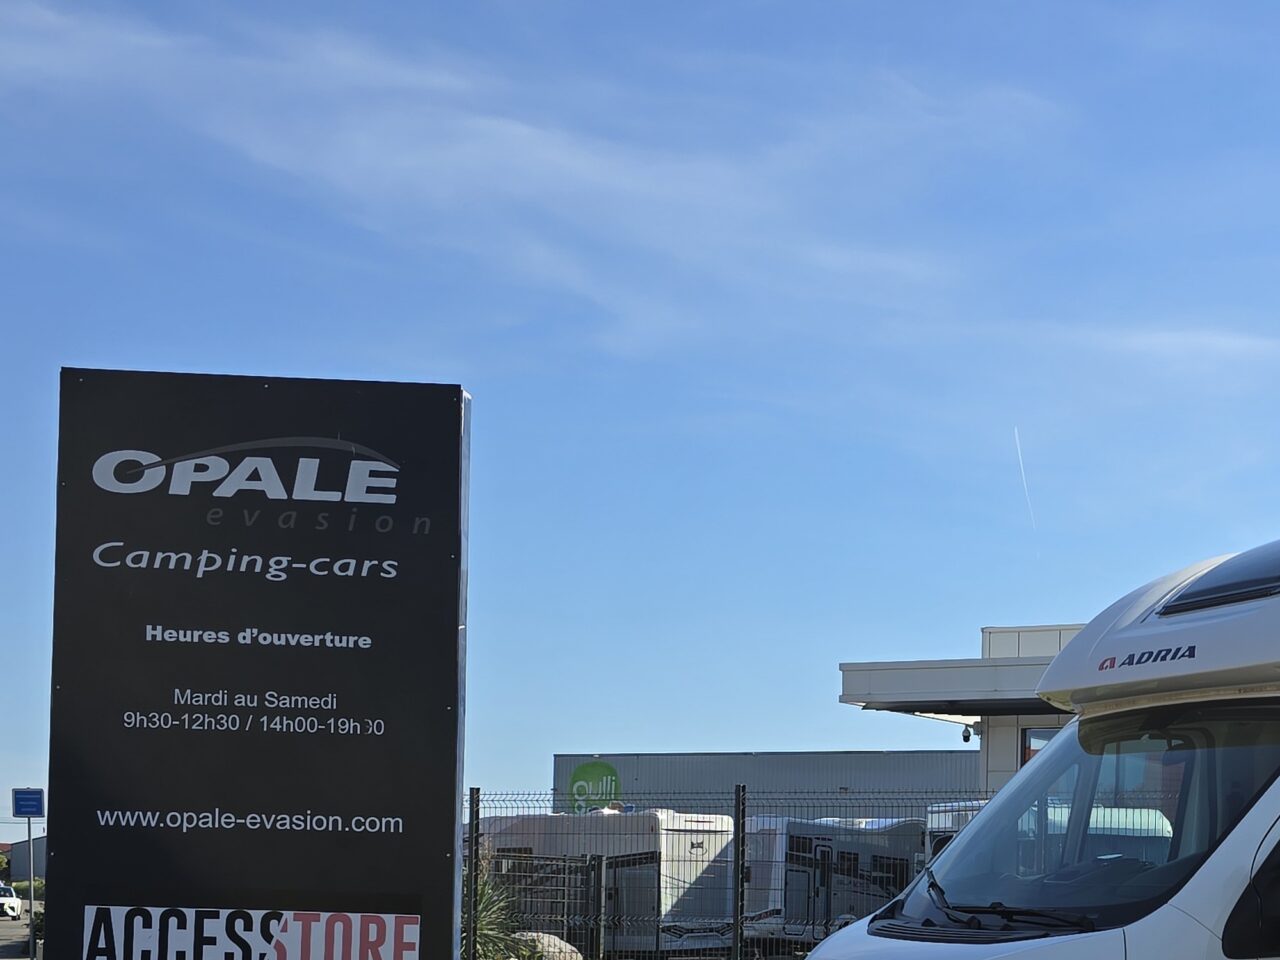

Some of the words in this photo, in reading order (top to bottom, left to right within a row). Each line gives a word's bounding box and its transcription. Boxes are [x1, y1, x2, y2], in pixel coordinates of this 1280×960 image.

[92, 450, 400, 504] OPALE
[206, 507, 431, 534] evasion
[92, 541, 399, 581] Camping-cars
[145, 624, 230, 644] Heures
[237, 628, 372, 648] d'ouverture
[1118, 645, 1197, 668] ADRIA
[174, 688, 228, 706] Mardi
[234, 694, 258, 708] au
[264, 691, 337, 709] Samedi
[123, 711, 240, 731] 9h30-12h30
[245, 714, 253, 731] /
[97, 808, 403, 833] www.opale-evasion.com
